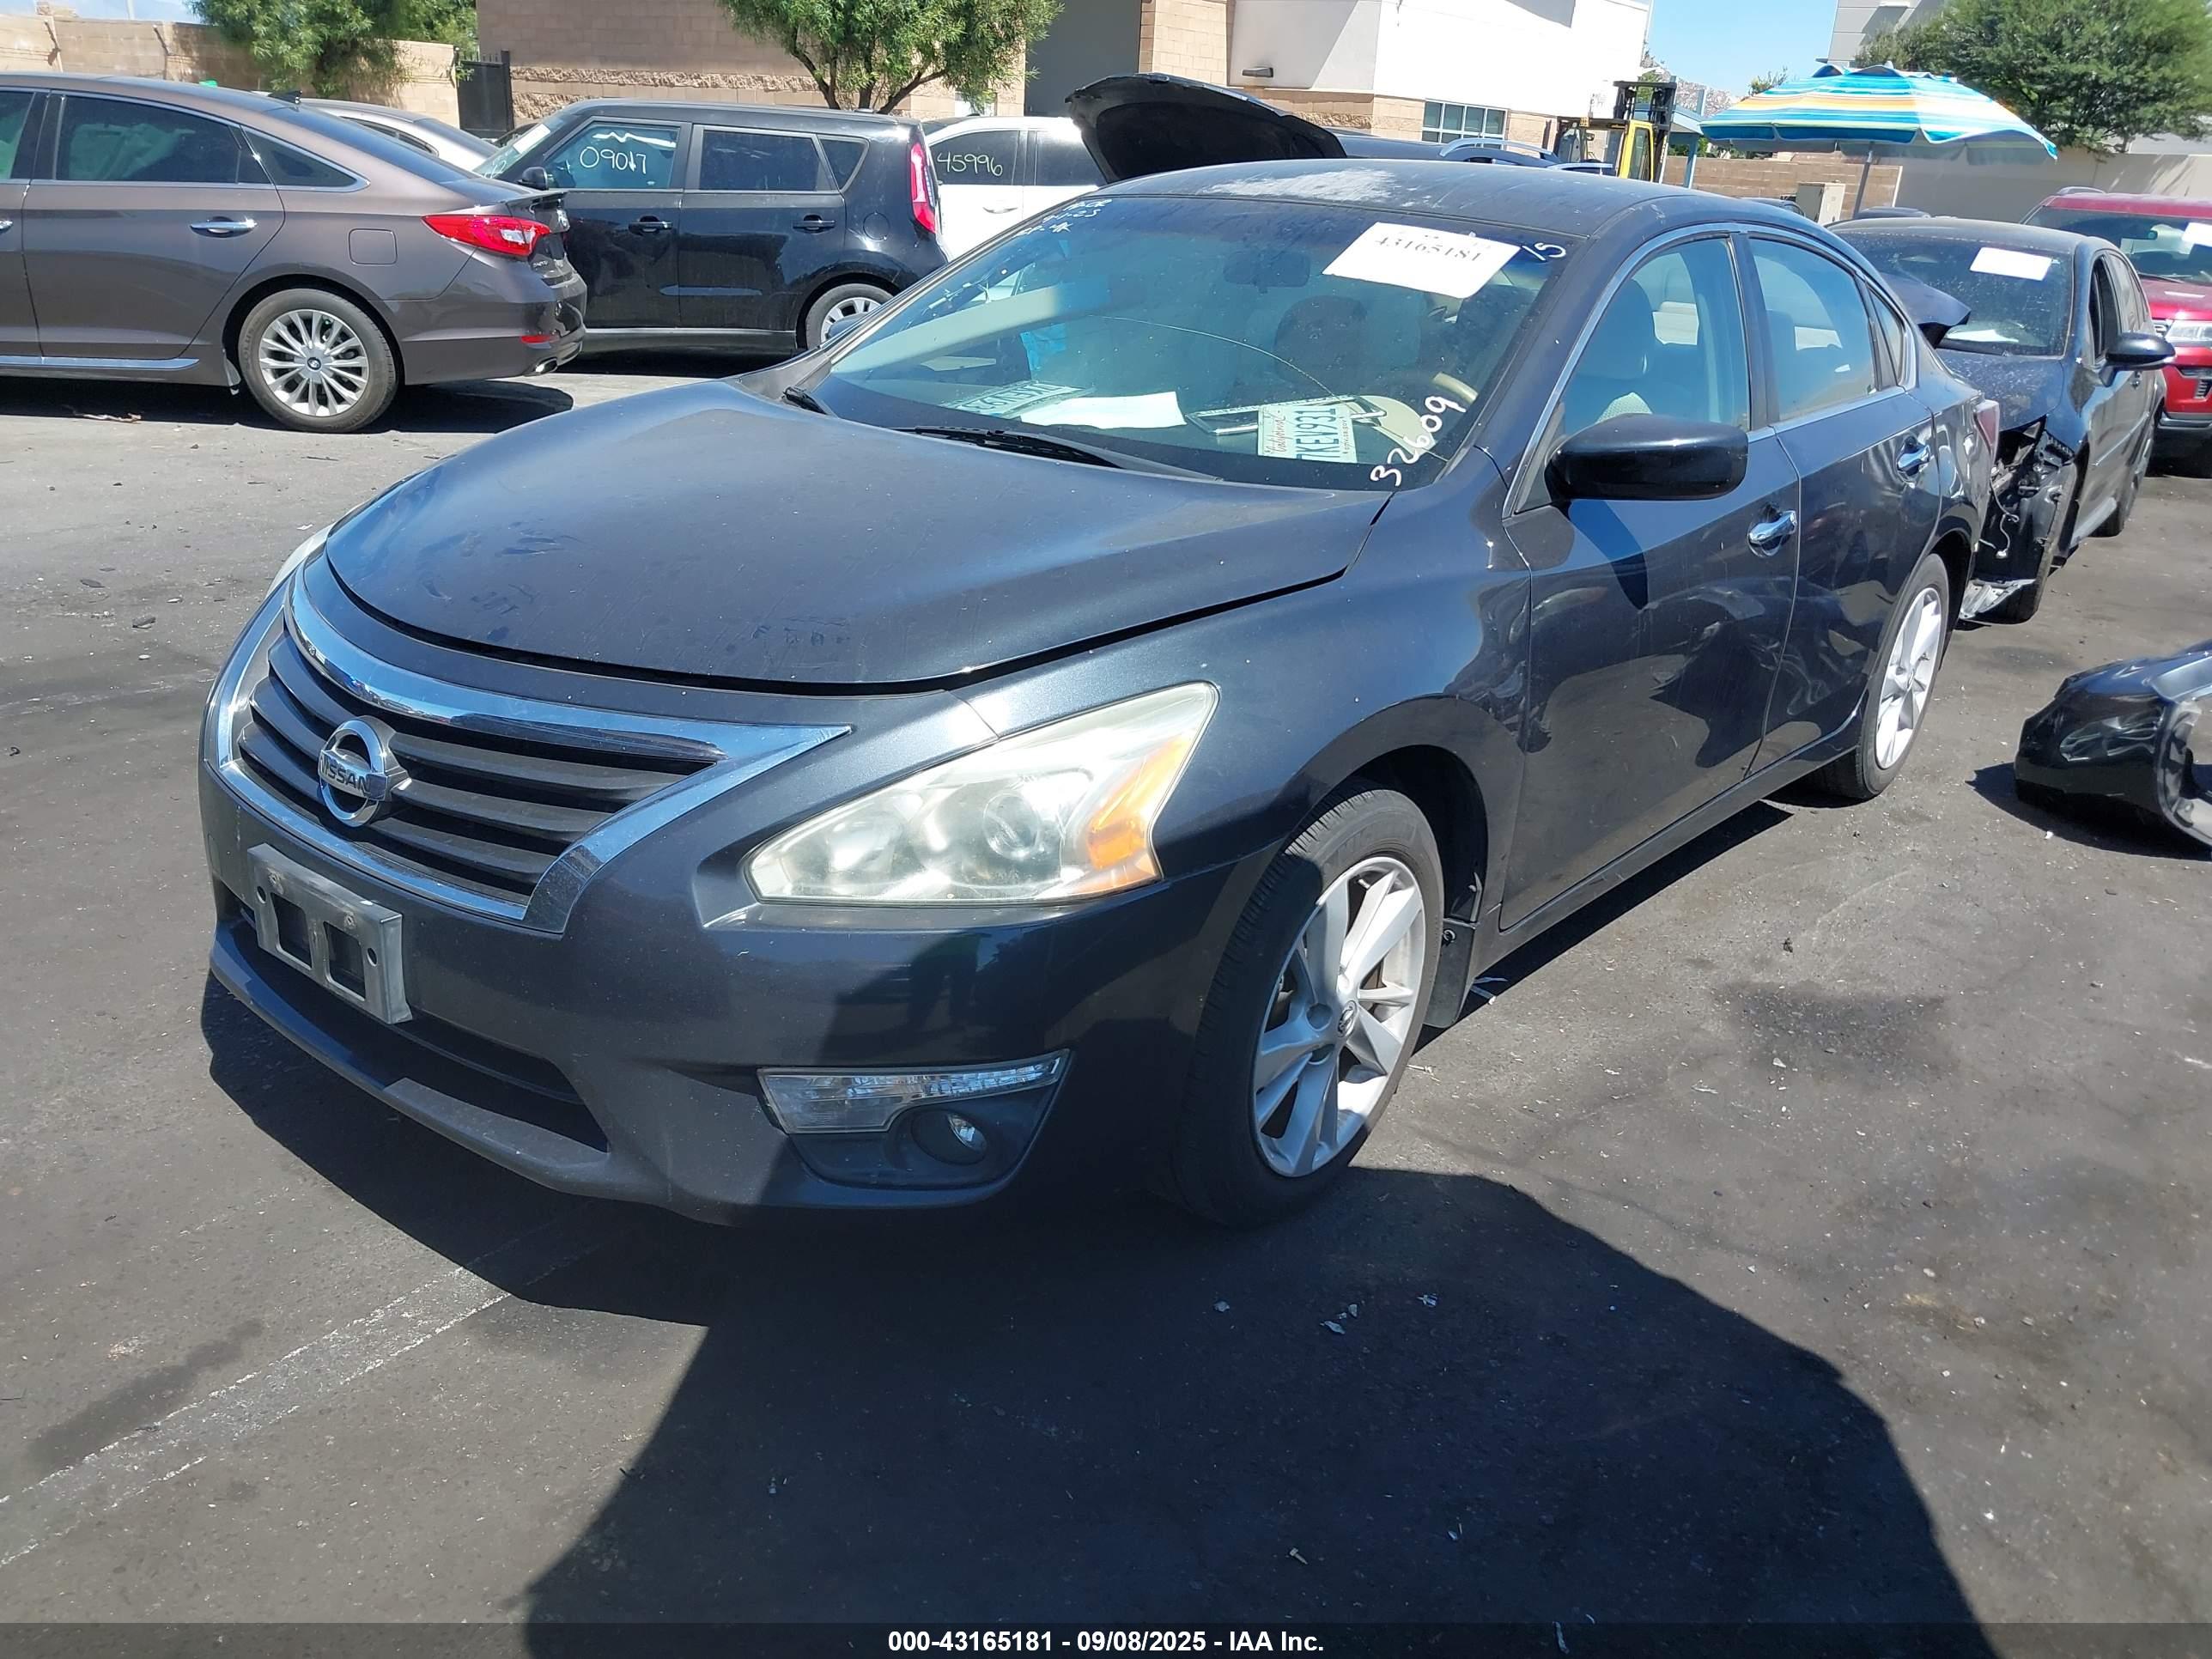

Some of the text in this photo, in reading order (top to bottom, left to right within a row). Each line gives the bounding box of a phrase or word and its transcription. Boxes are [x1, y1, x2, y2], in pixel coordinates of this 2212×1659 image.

[936, 150, 1003, 177] 45996
[1294, 408, 1340, 460] 7KEV931
[1370, 396, 1467, 487] 32609
[319, 752, 371, 796] NISSAN
